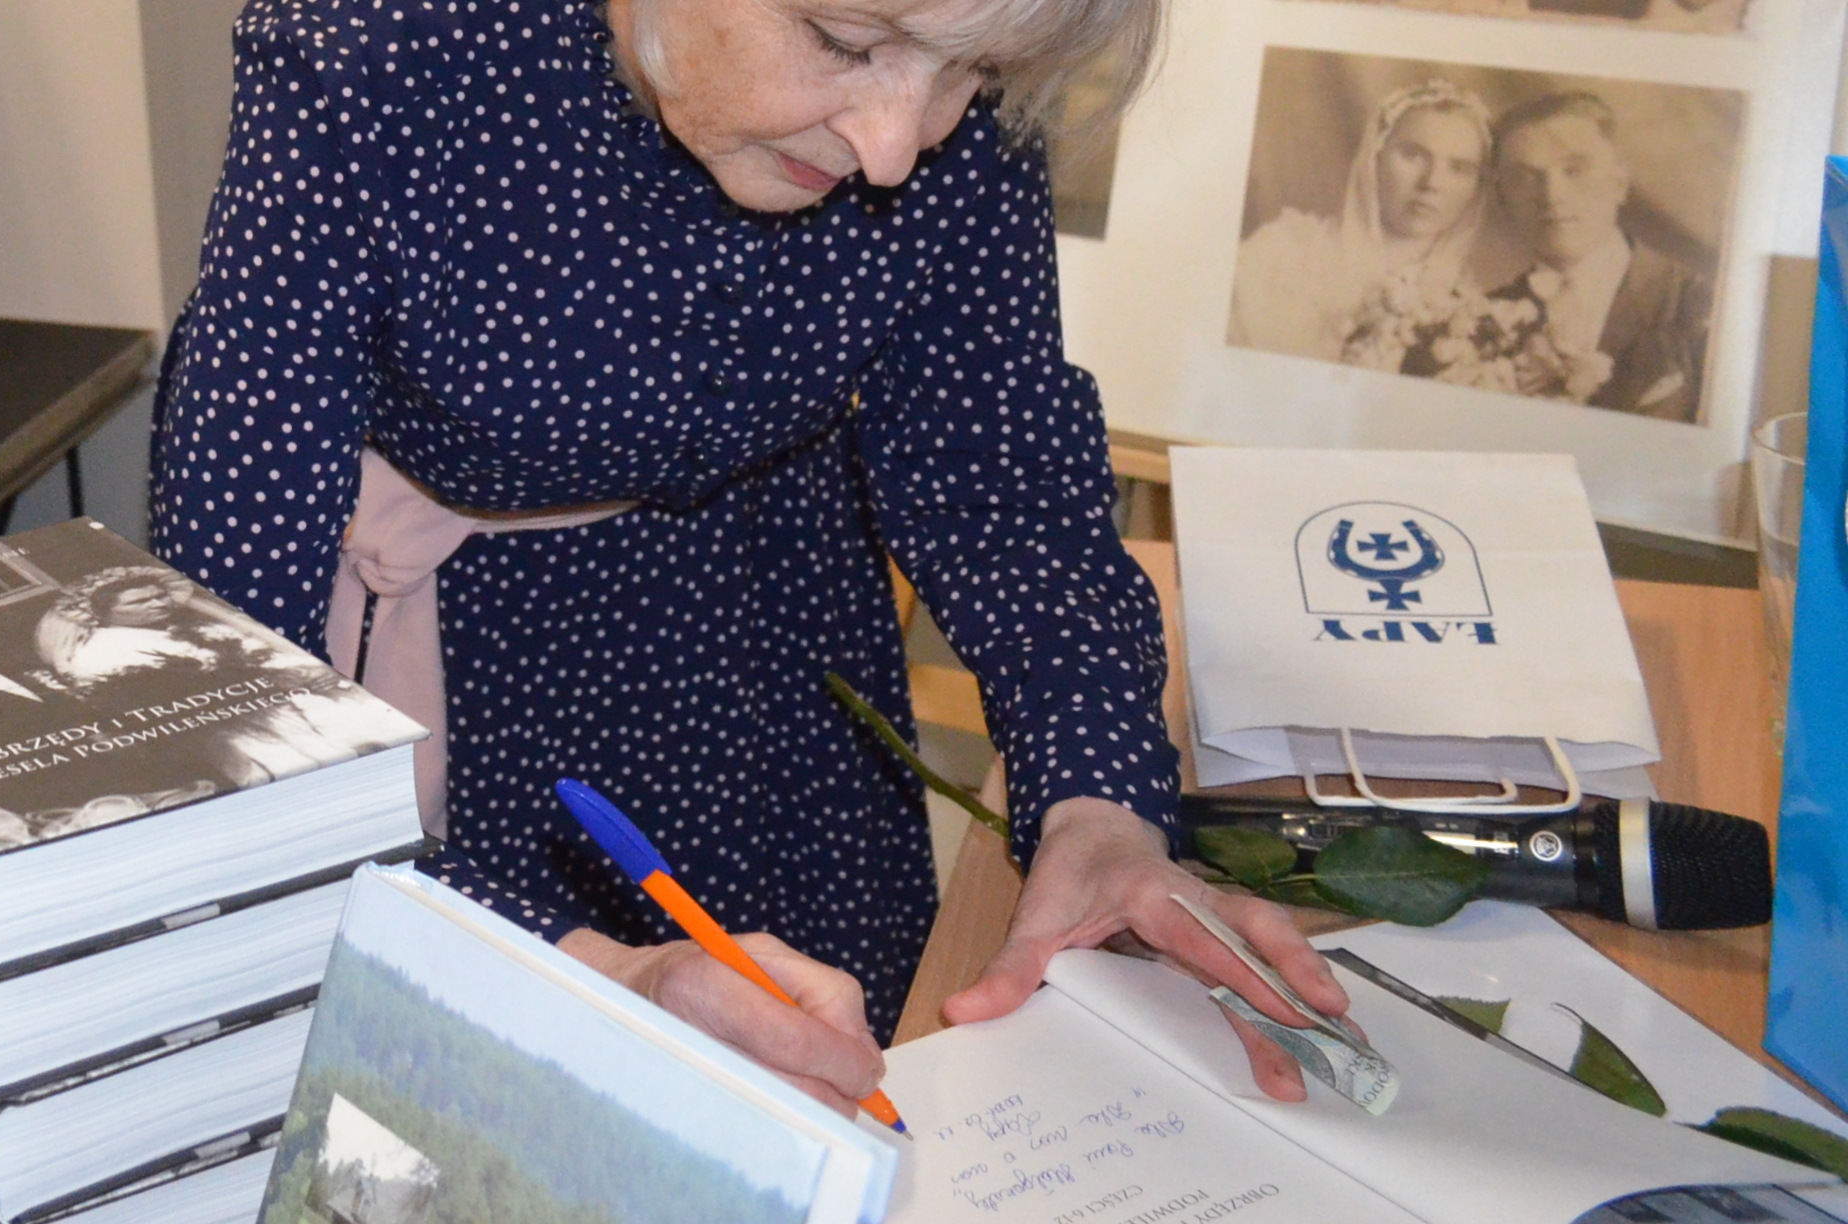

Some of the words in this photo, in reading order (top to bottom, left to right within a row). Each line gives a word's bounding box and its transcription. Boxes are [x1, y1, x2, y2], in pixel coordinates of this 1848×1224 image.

[1313, 619, 1501, 645] ŁAPY
[125, 676, 275, 724] TRADYCJE
[73, 687, 312, 758] PODWILEŃSKIEGO
[1086, 1184, 1144, 1214] CZĘŚCI
